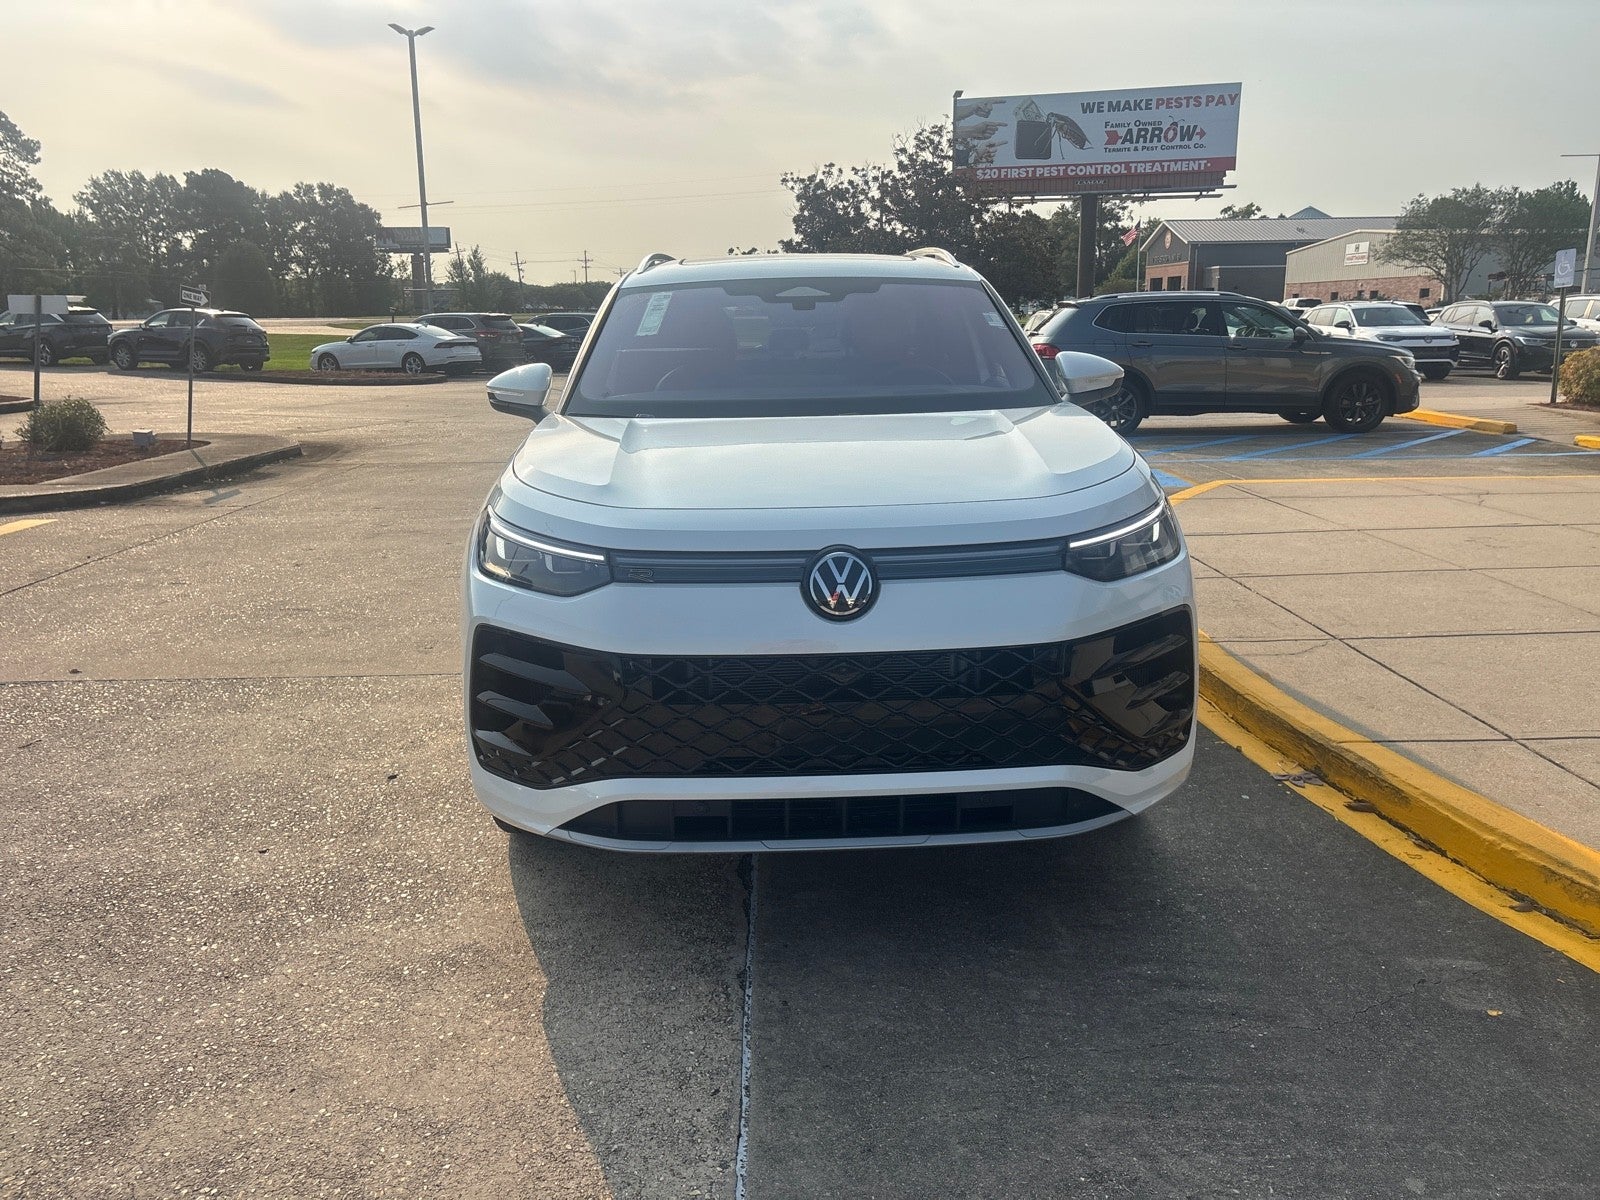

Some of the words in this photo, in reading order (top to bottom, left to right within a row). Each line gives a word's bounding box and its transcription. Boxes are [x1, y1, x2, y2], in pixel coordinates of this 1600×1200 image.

[1080, 101, 1105, 114] WE
[1107, 98, 1153, 112] MAKE
[1155, 95, 1203, 110] PESTS
[1205, 93, 1239, 107] PAY
[1104, 121, 1131, 129] FAMILY
[1133, 119, 1163, 128] OWNED
[1121, 124, 1198, 145] ARROW
[1161, 143, 1192, 151] CONTROL
[976, 168, 999, 180] $20
[1000, 167, 1034, 178] FIRST
[1035, 165, 1066, 177] PEST
[1067, 163, 1127, 176] CONTROL
[183, 291, 193, 300] ONE
[193, 294, 202, 302] WAY
